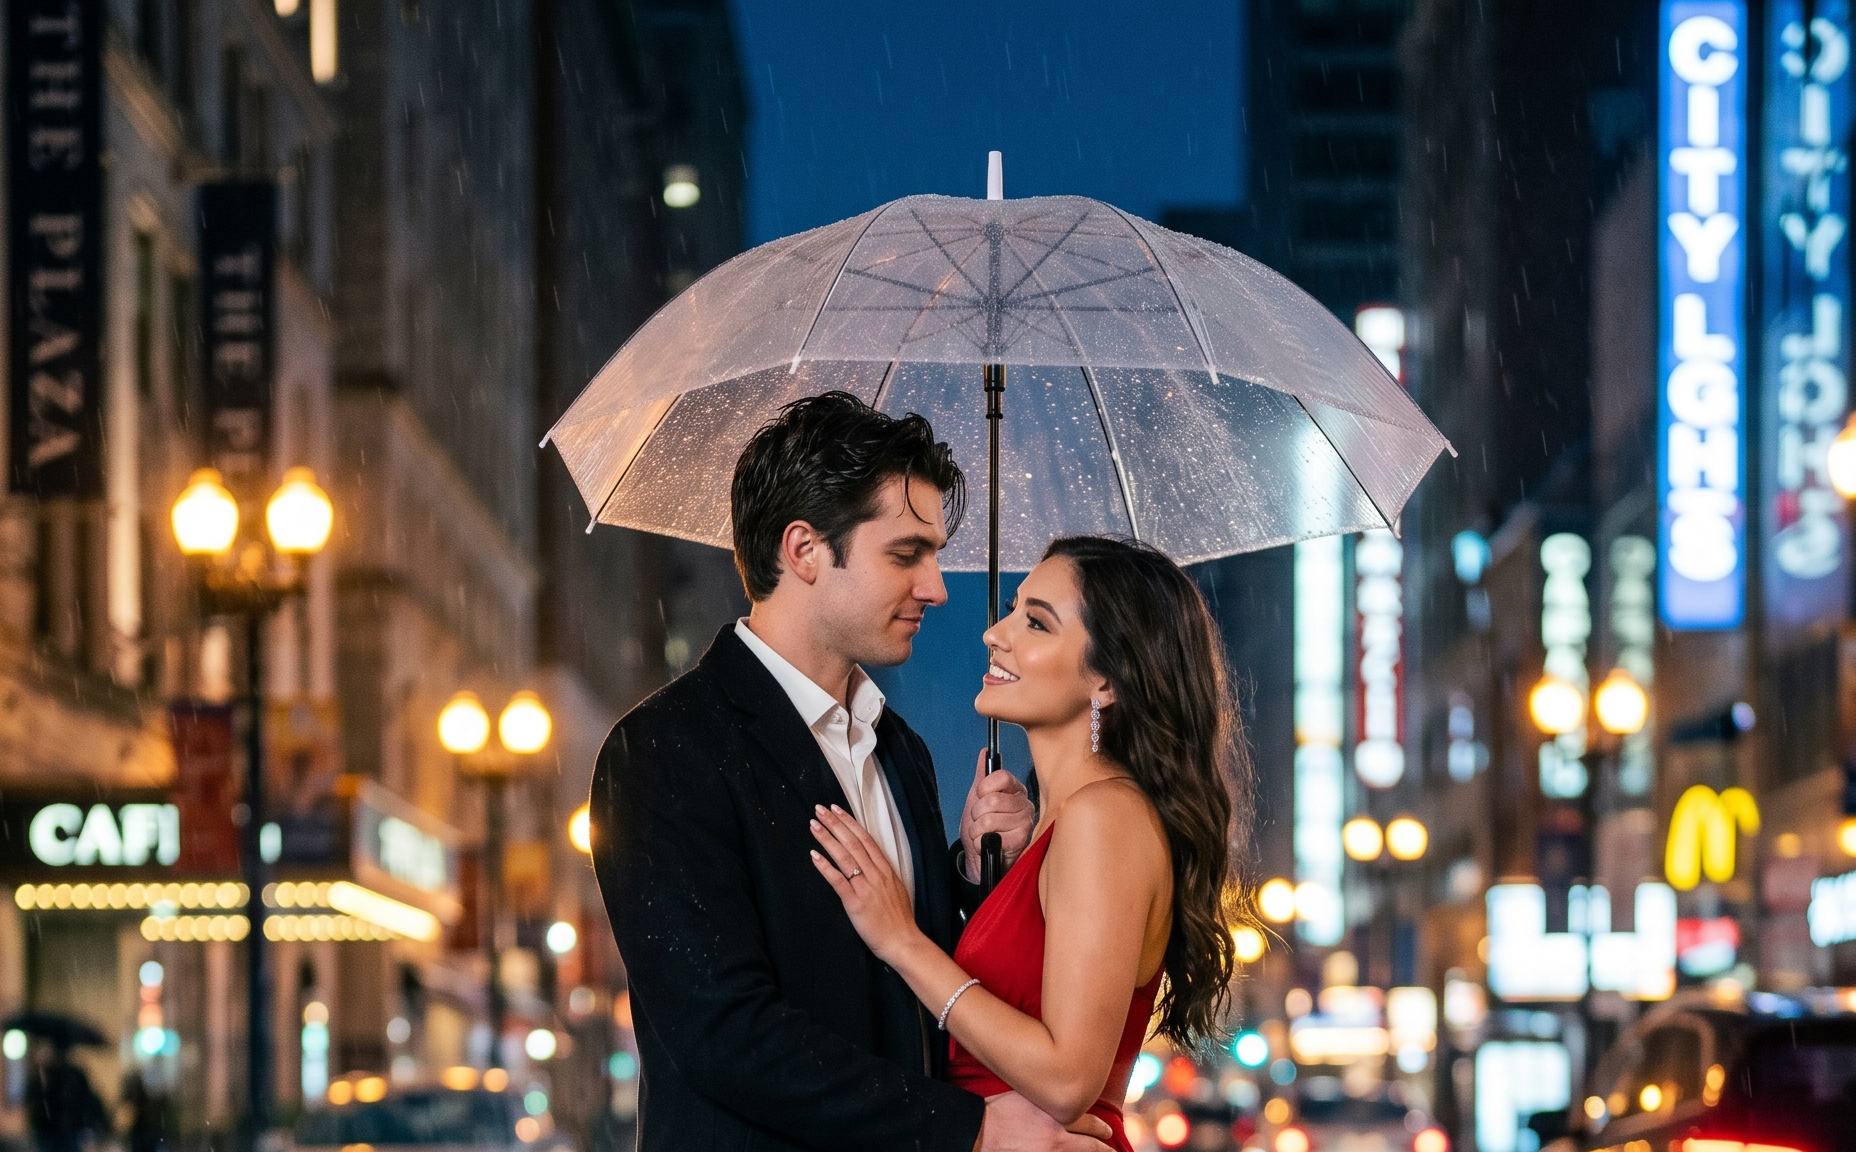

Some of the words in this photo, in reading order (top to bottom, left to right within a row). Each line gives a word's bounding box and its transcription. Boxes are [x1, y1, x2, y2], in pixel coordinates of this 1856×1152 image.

[28, 3, 83, 170] THE
[1668, 15, 1739, 284] CITY
[28, 212, 84, 467] PLAZA
